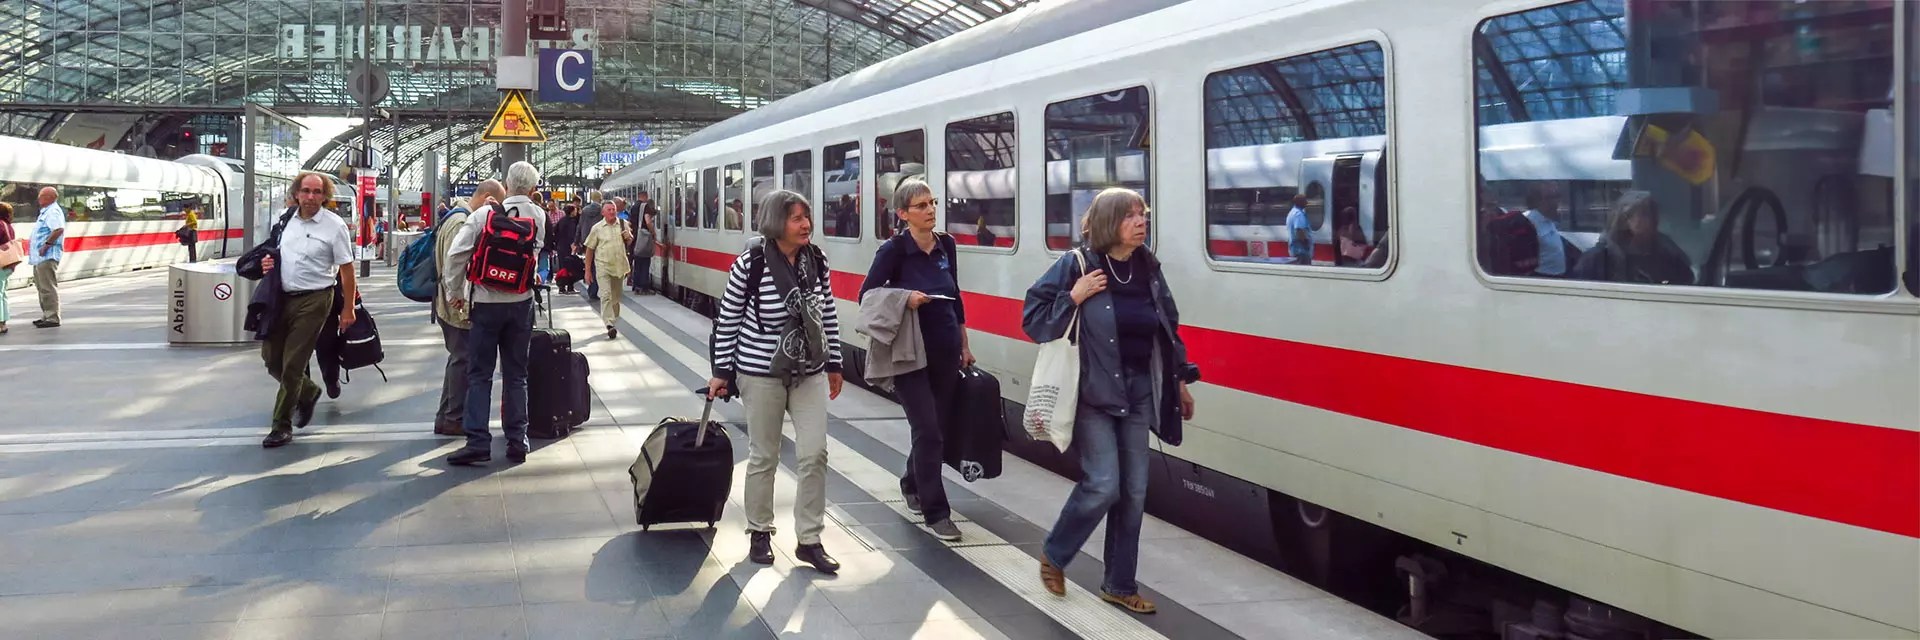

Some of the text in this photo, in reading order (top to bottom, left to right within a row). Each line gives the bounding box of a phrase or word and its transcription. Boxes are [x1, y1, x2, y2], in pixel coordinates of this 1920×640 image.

[555, 51, 585, 91] C
[489, 268, 516, 280] ORF
[173, 290, 185, 334] Abfall
